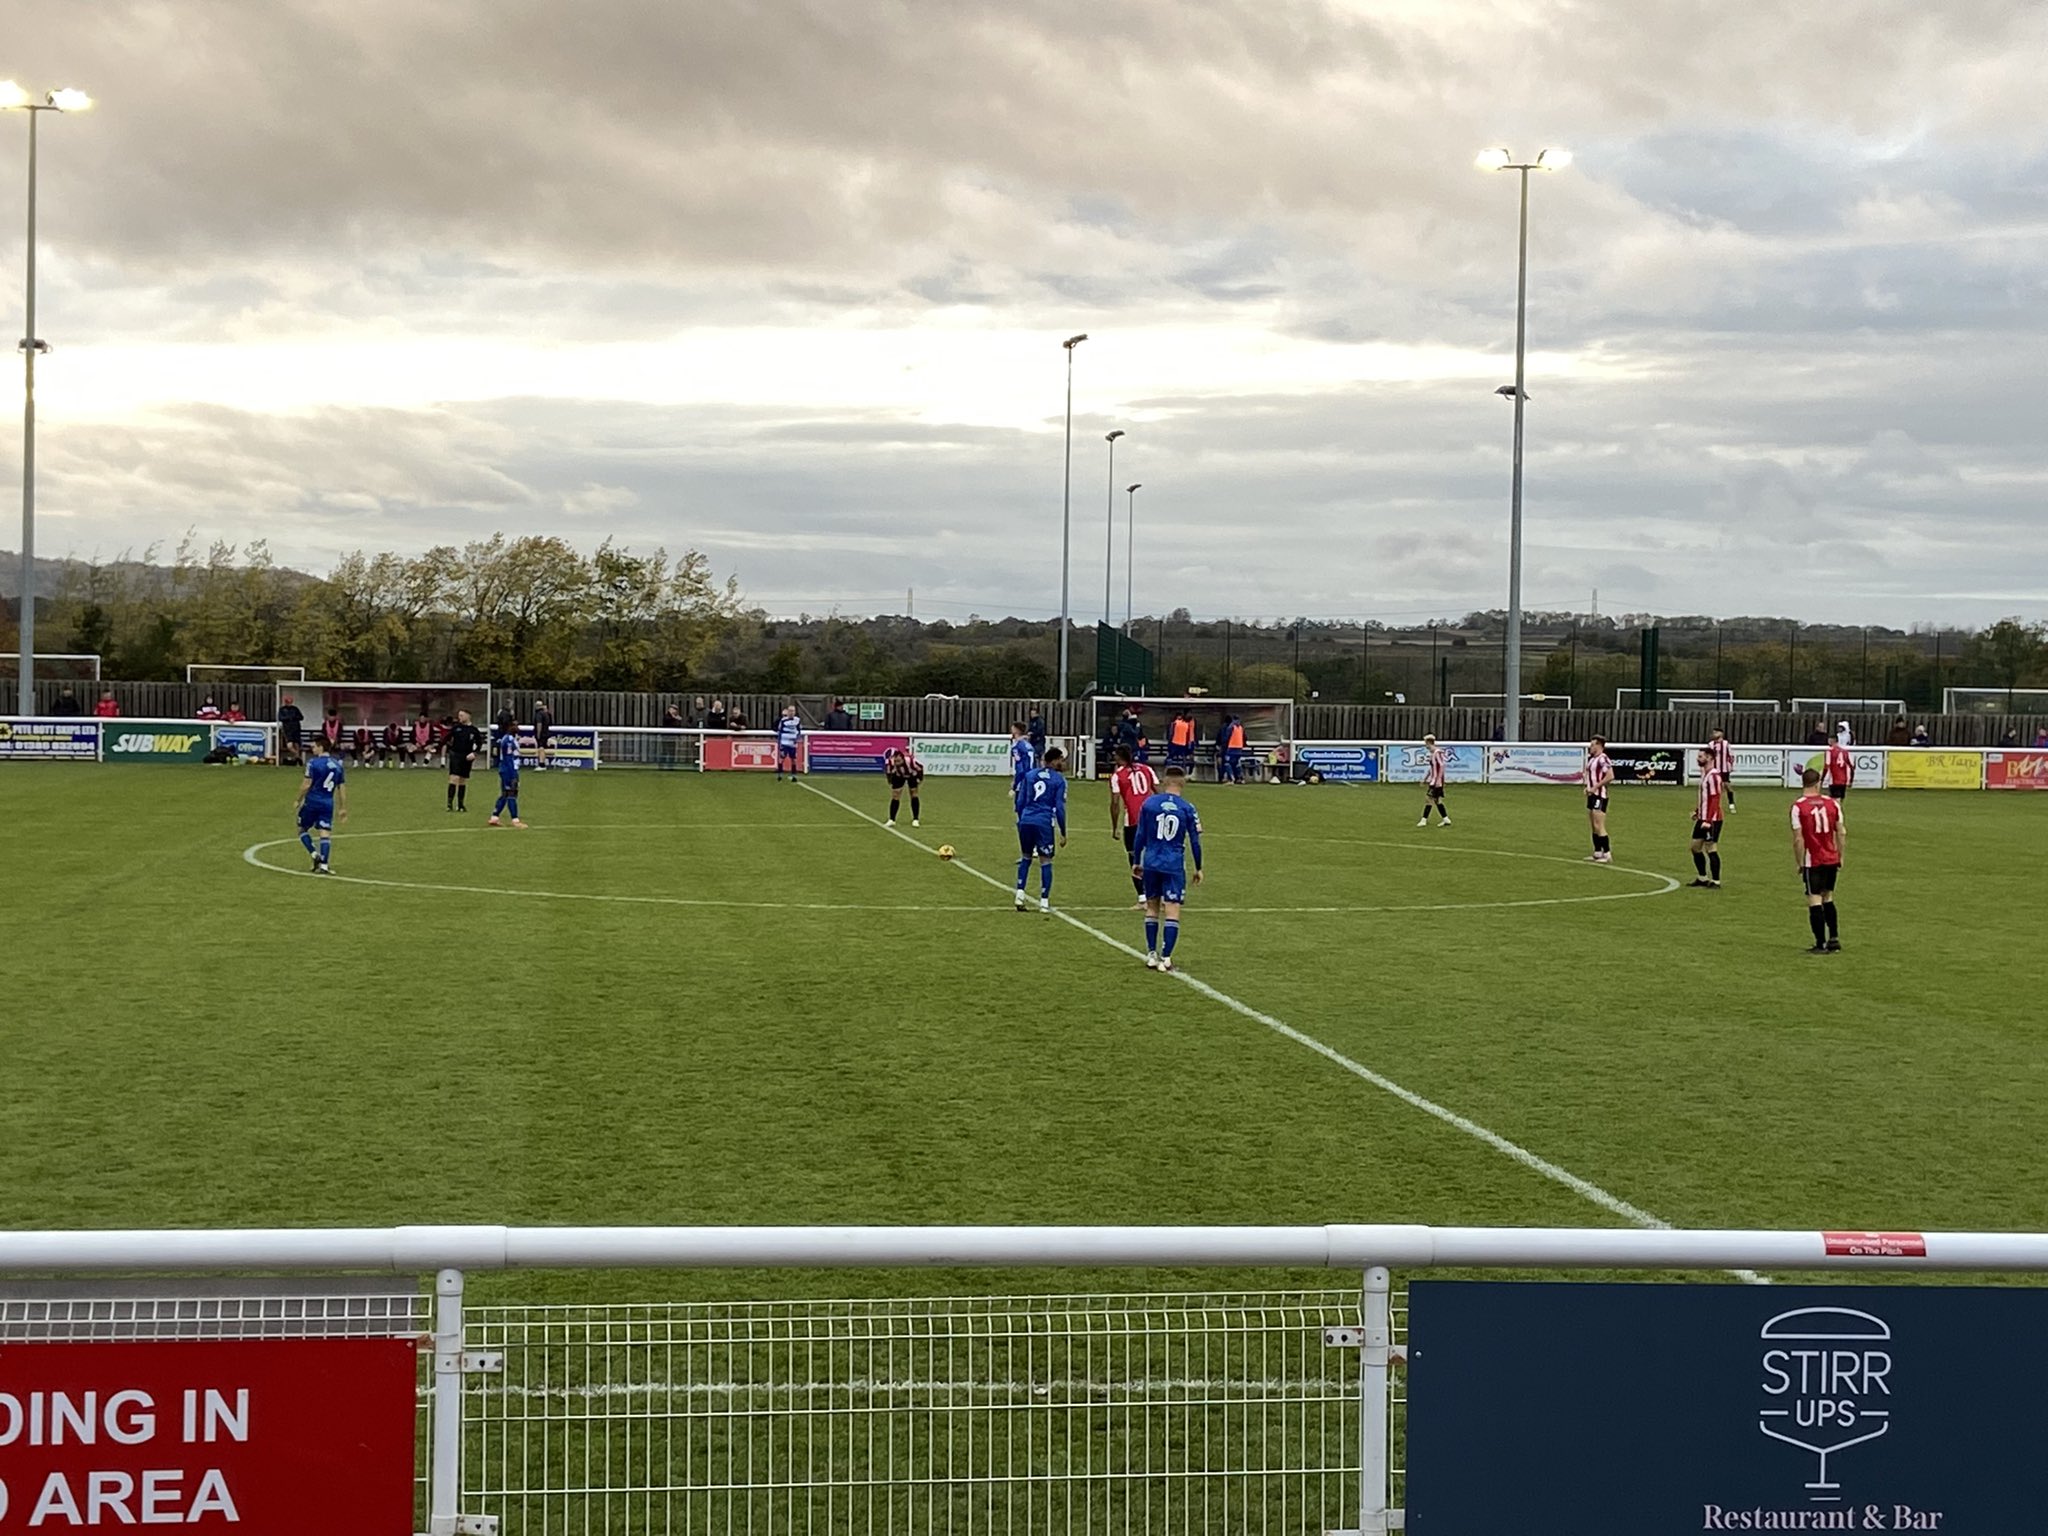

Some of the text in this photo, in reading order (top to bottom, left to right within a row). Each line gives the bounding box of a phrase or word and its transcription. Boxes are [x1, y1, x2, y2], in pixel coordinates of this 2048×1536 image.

[112, 733, 202, 753] SUBWAY
[916, 742, 1009, 755] SnatchPac Ltd
[1547, 749, 1582, 757] Limited
[927, 763, 997, 773] 0121 753 2223
[1634, 761, 1678, 771] SPORTS
[323, 771, 335, 792] 4
[1033, 781, 1047, 801] 9
[1127, 771, 1149, 796] 10
[1155, 812, 1180, 842] 10
[1810, 806, 1830, 834] 11
[1849, 1246, 1903, 1255] On The Pitch
[1882, 1238, 1924, 1247] Personnel
[1762, 1350, 1892, 1394] STIRR
[182, 1389, 249, 1443] IN
[1796, 1400, 1856, 1427] UPS
[27, 1468, 241, 1527] AREA
[1703, 1504, 1943, 1530] Restaurant & Bar
